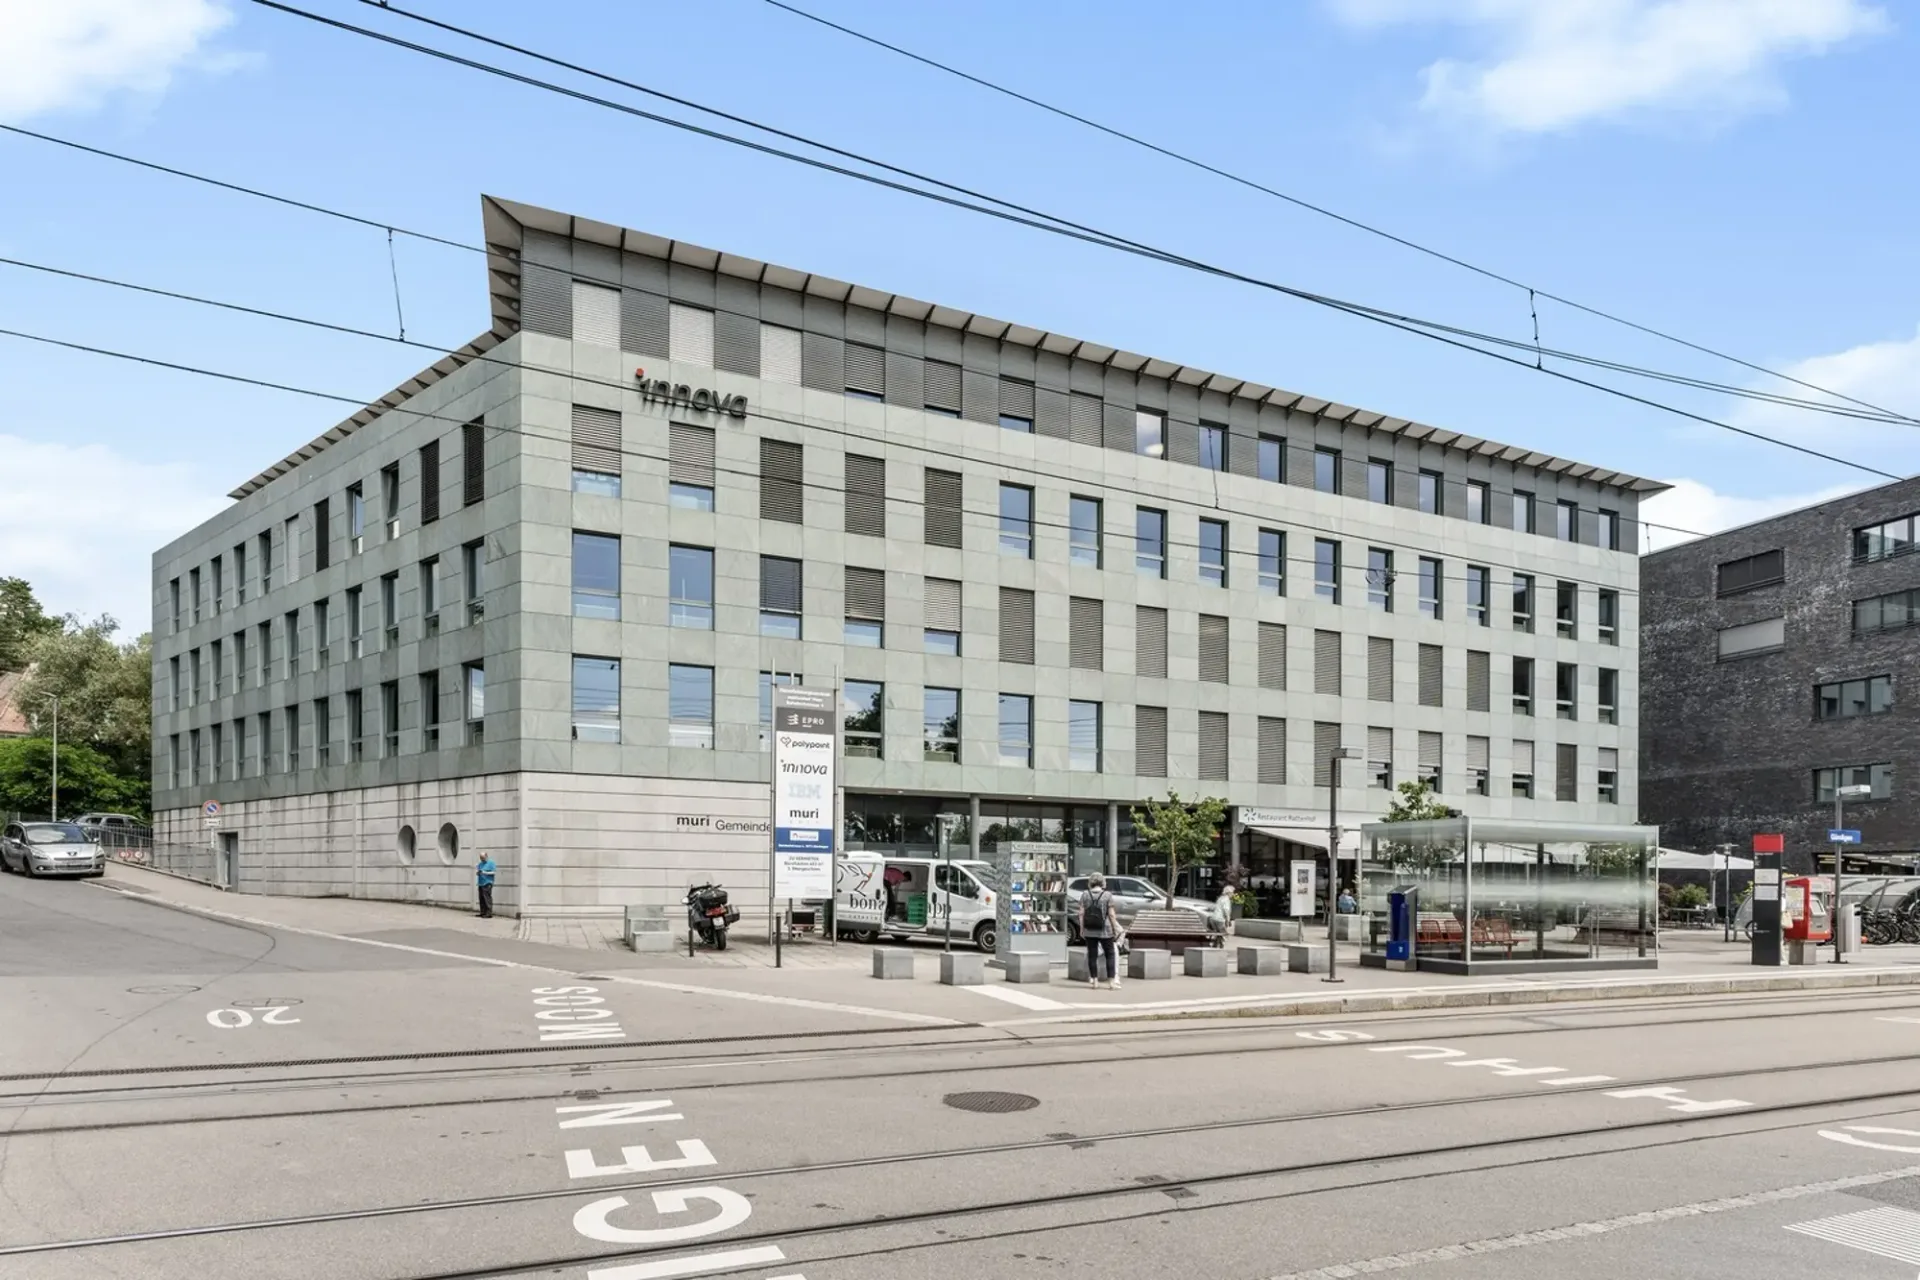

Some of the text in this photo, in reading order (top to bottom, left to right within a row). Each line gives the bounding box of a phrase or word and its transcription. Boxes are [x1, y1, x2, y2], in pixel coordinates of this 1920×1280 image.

[635, 367, 748, 418] innova
[792, 740, 830, 749] polypoint
[780, 759, 828, 775] innova
[788, 783, 822, 799] IBM
[676, 814, 710, 826] muri
[789, 808, 819, 819] muri
[206, 1006, 301, 1029] 20
[531, 986, 626, 1041] MOOS
[556, 1099, 806, 1280] IGEN
